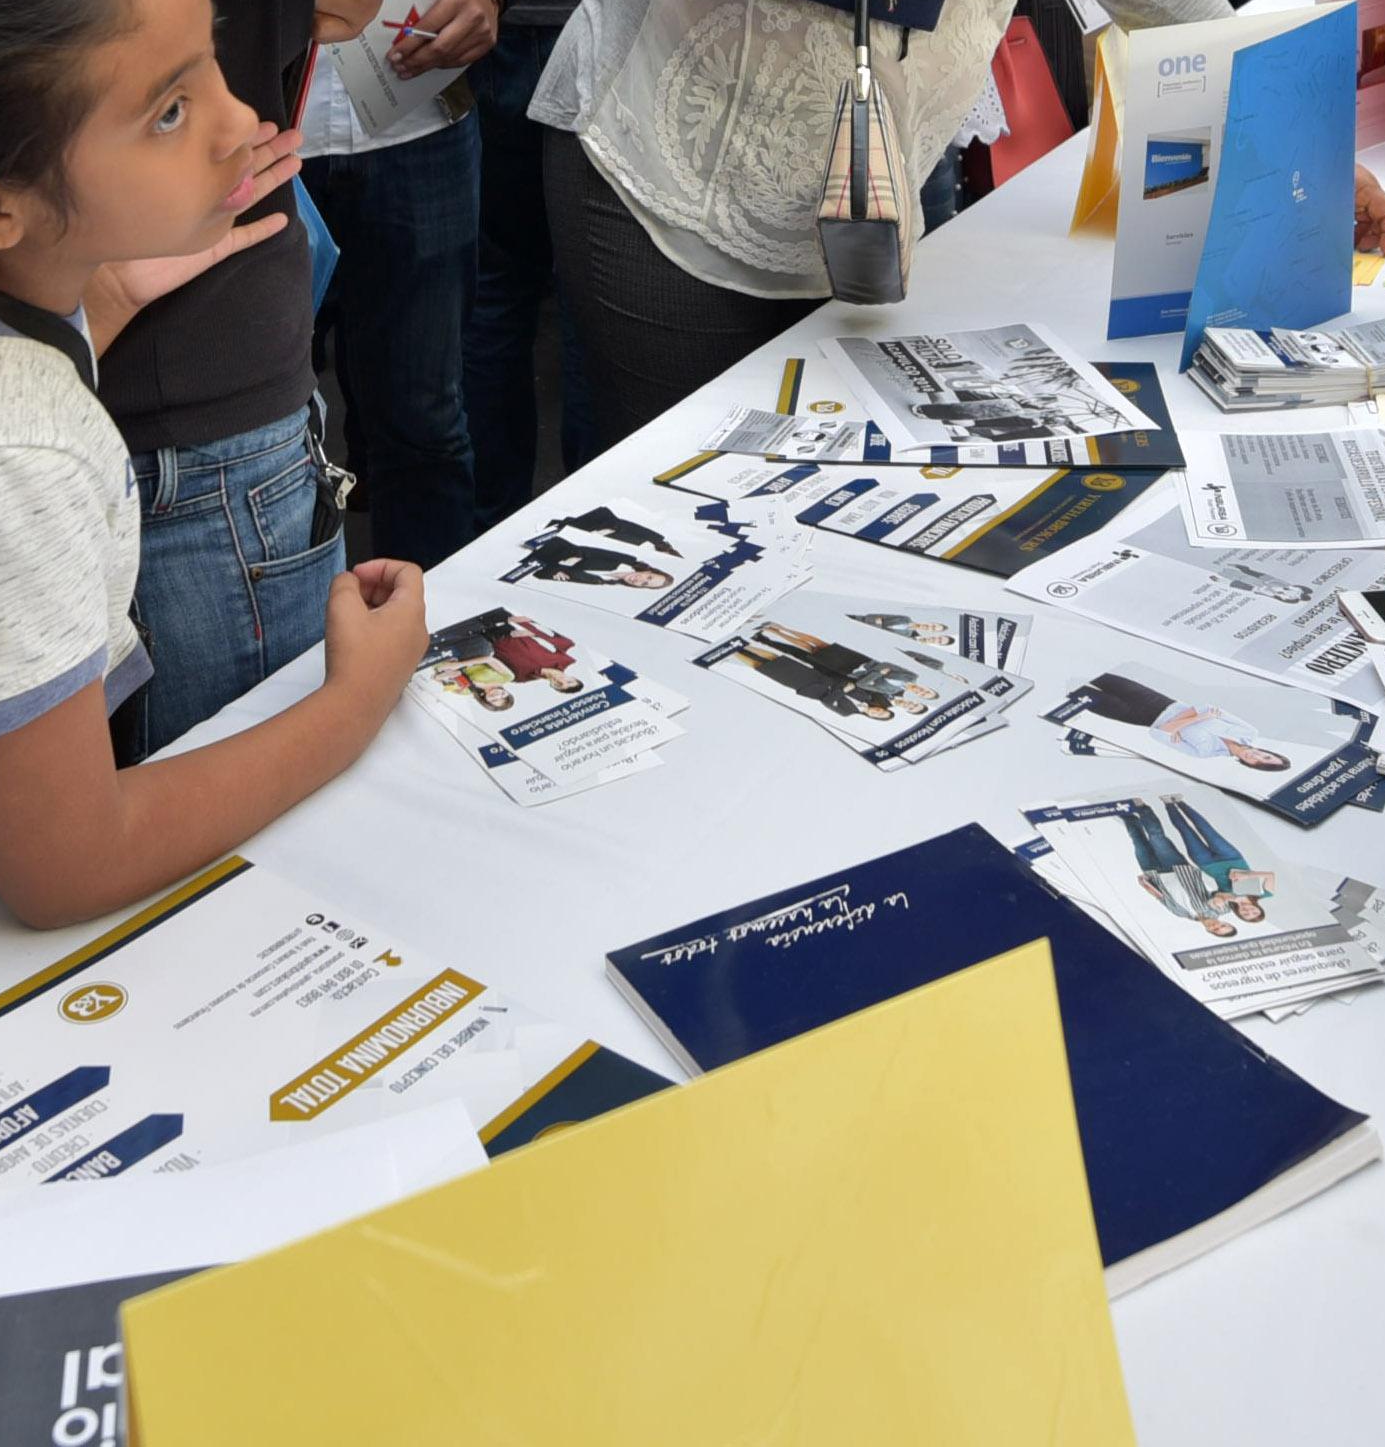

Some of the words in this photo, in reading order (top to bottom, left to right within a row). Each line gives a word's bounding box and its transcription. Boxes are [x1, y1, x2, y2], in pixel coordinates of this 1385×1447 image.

[1158, 53, 1206, 77] one
[885, 343, 920, 376] ACAPULCO
[936, 338, 962, 361] SOLO
[1312, 557, 1353, 586] OFRECEMOS
[1314, 623, 1333, 637] dan
[568, 691, 607, 711] Asesor
[511, 708, 568, 735] Financiero
[545, 702, 610, 732] Conviértete
[529, 727, 544, 737] en
[560, 749, 602, 771] horario
[600, 747, 614, 757] un
[1320, 760, 1340, 779] gana
[1336, 769, 1355, 784] tus
[1296, 775, 1325, 794] dinero
[1295, 781, 1341, 812] actividades
[727, 906, 814, 942] hacemos
[766, 902, 875, 948] diferencia
[661, 934, 718, 965] todos
[1278, 952, 1317, 967] seguir
[1317, 946, 1345, 961] para
[1201, 960, 1277, 983] estudiando?
[1264, 971, 1280, 983] de
[1280, 958, 1351, 982] ¿Requieres
[1208, 974, 1264, 992] ingresos
[336, 979, 469, 1075] INBURNOMINA
[449, 1017, 492, 1048] NOMBRE
[437, 1042, 455, 1061] DEL
[388, 1054, 440, 1094] CONCEPTO
[280, 1068, 352, 1114] TOTAL
[53, 1099, 108, 1138] CUENTAS
[35, 1129, 55, 1150] DE
[32, 1133, 90, 1174] CRÉDITO
